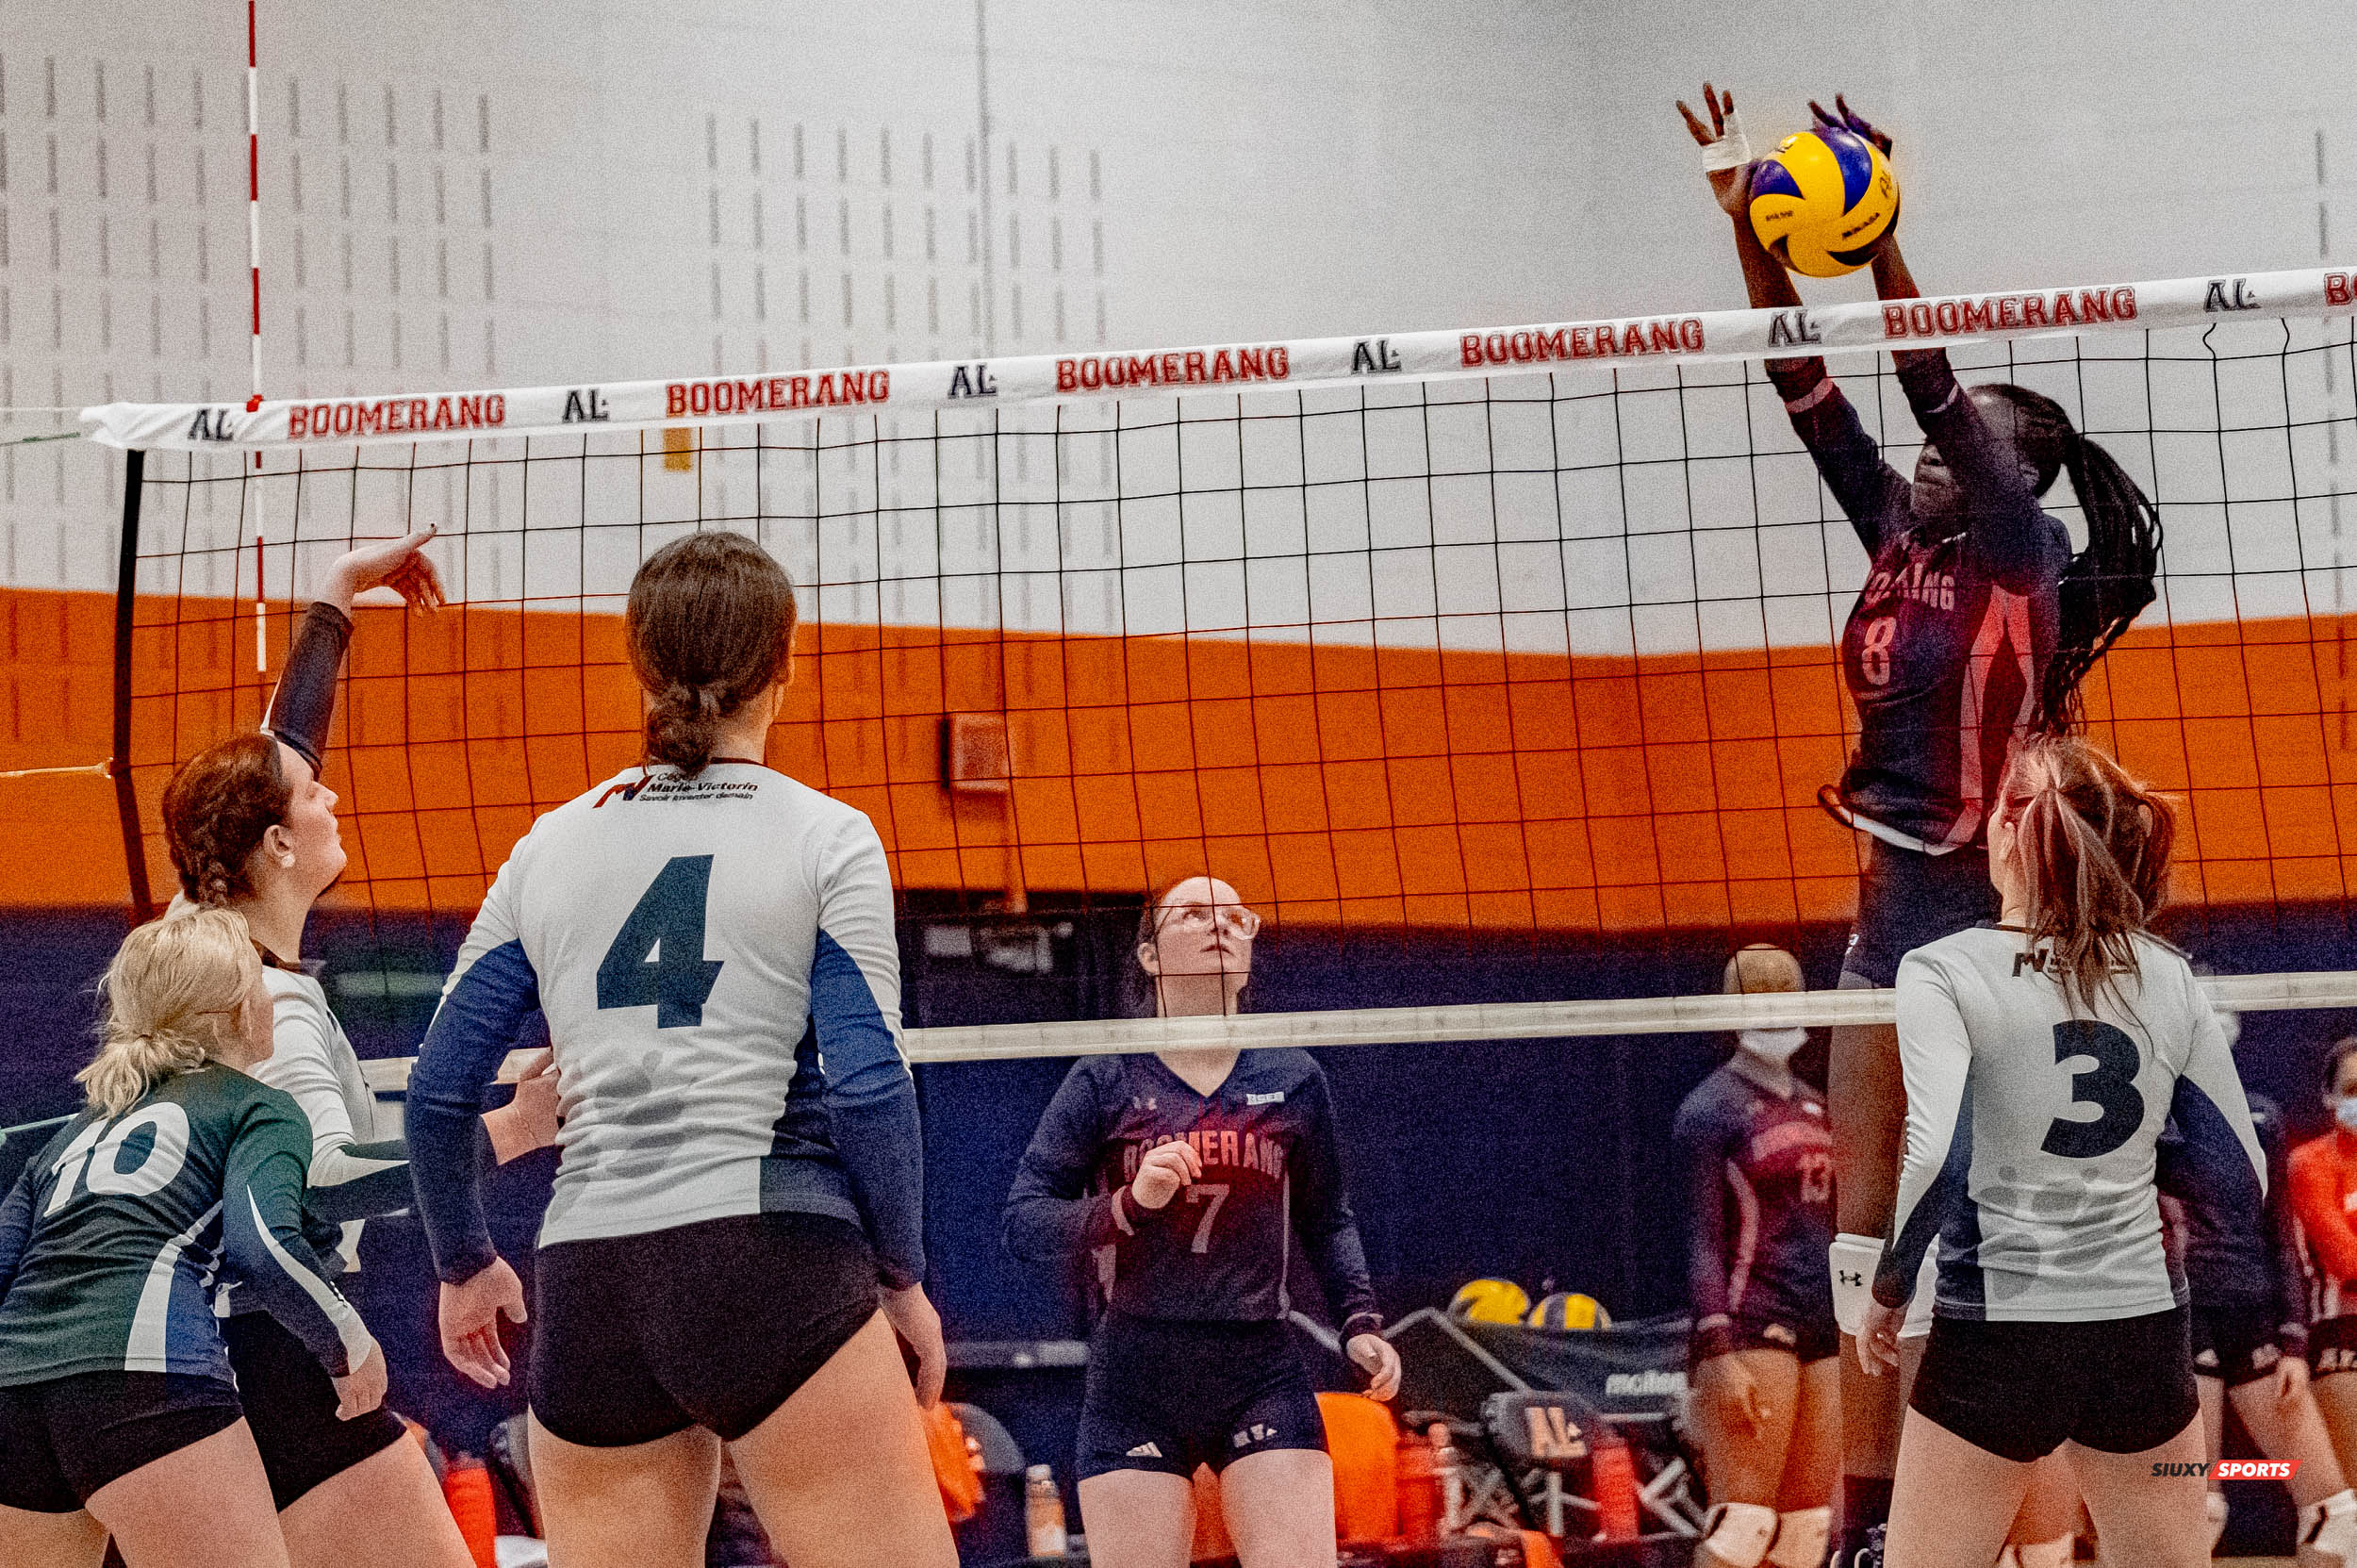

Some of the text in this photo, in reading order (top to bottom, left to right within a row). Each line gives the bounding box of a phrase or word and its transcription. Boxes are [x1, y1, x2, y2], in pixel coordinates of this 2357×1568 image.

[288, 393, 505, 439] BOOMERANG
[562, 388, 609, 423] AL
[666, 369, 891, 418] BOOMERANG
[948, 363, 997, 399] AL
[1056, 346, 1290, 393] BOOMERANG
[1350, 338, 1402, 374] AL
[1460, 317, 1706, 368] BOOMERANG
[1768, 309, 1822, 347] AL
[1881, 286, 2137, 339] BOOMERANG
[2203, 278, 2262, 313] AL
[2324, 272, 2357, 306] B
[1862, 617, 1897, 686] 8
[647, 782, 759, 793] Marie-Victorin
[596, 854, 725, 1030] 4
[2040, 1019, 2145, 1159] 3
[43, 1101, 190, 1218] 10
[1185, 1183, 1230, 1254] 7
